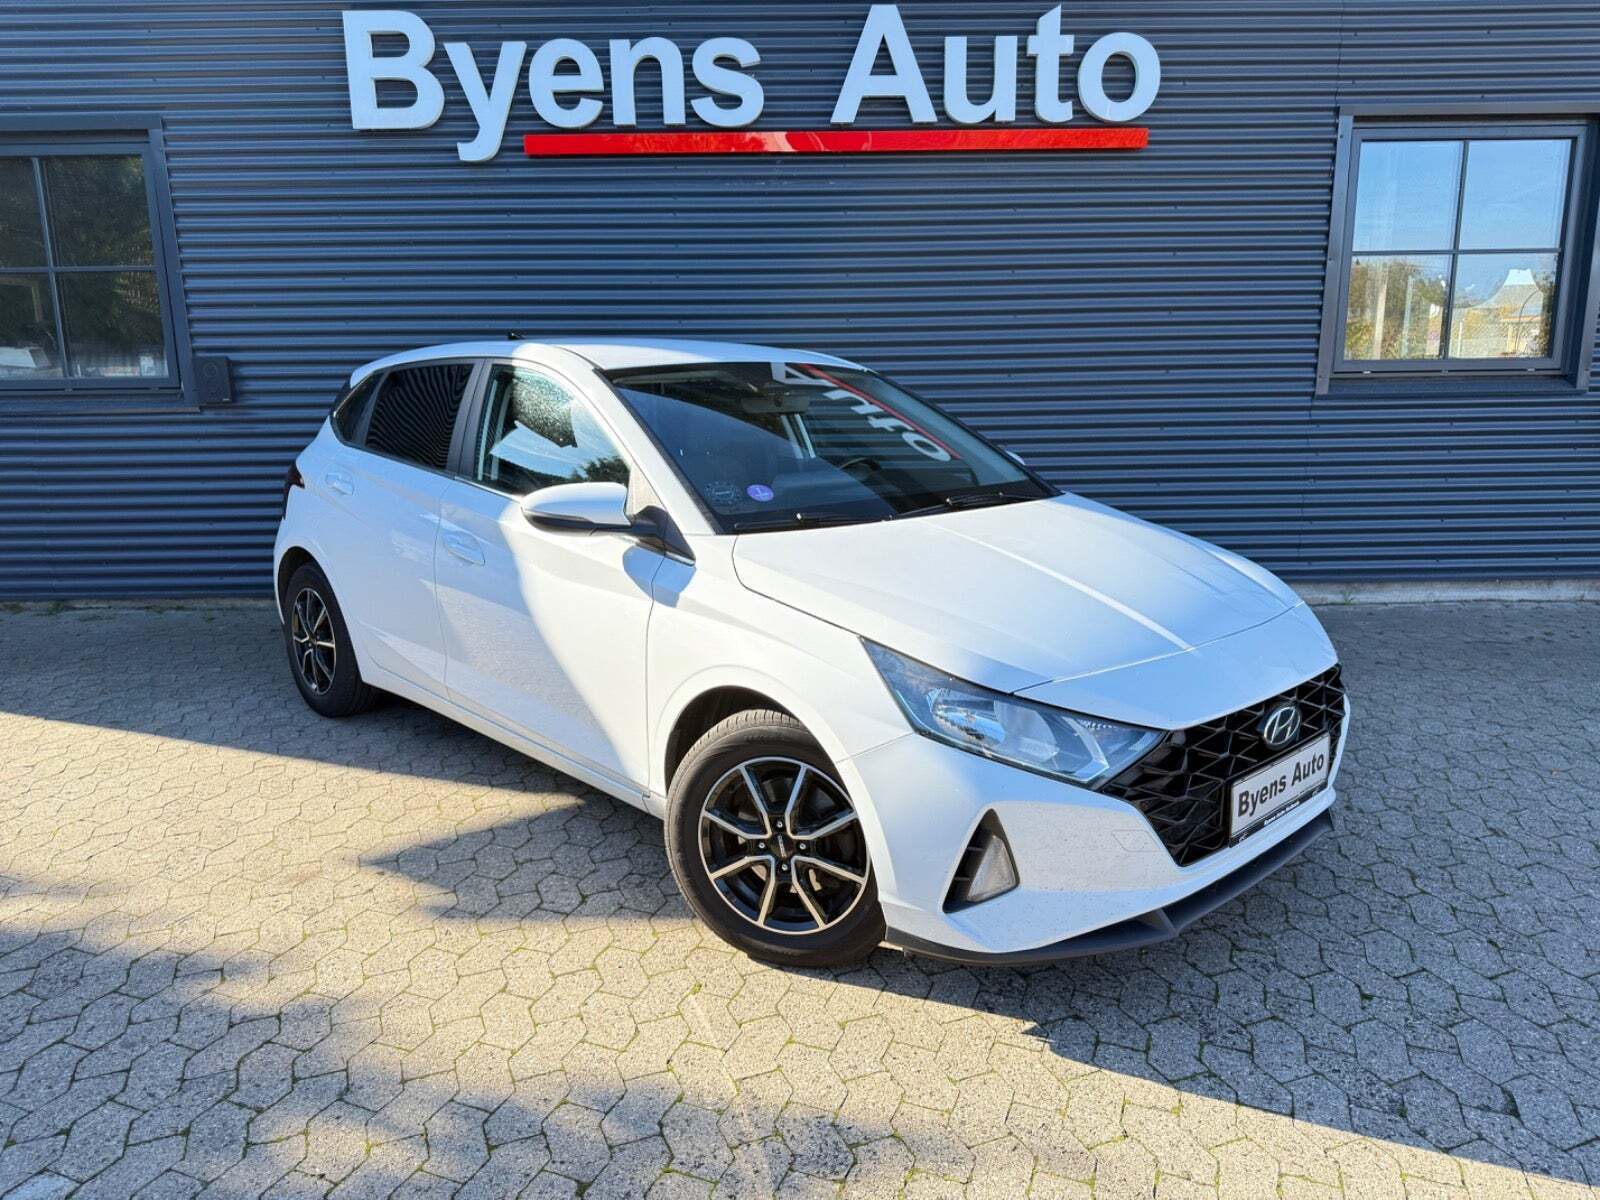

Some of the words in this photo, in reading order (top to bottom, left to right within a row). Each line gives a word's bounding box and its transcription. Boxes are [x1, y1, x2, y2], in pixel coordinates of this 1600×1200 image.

[342, 9, 765, 163] Byens
[830, 4, 1163, 127] Auto
[1238, 774, 1287, 817] Byens
[1292, 753, 1324, 785] Auto
